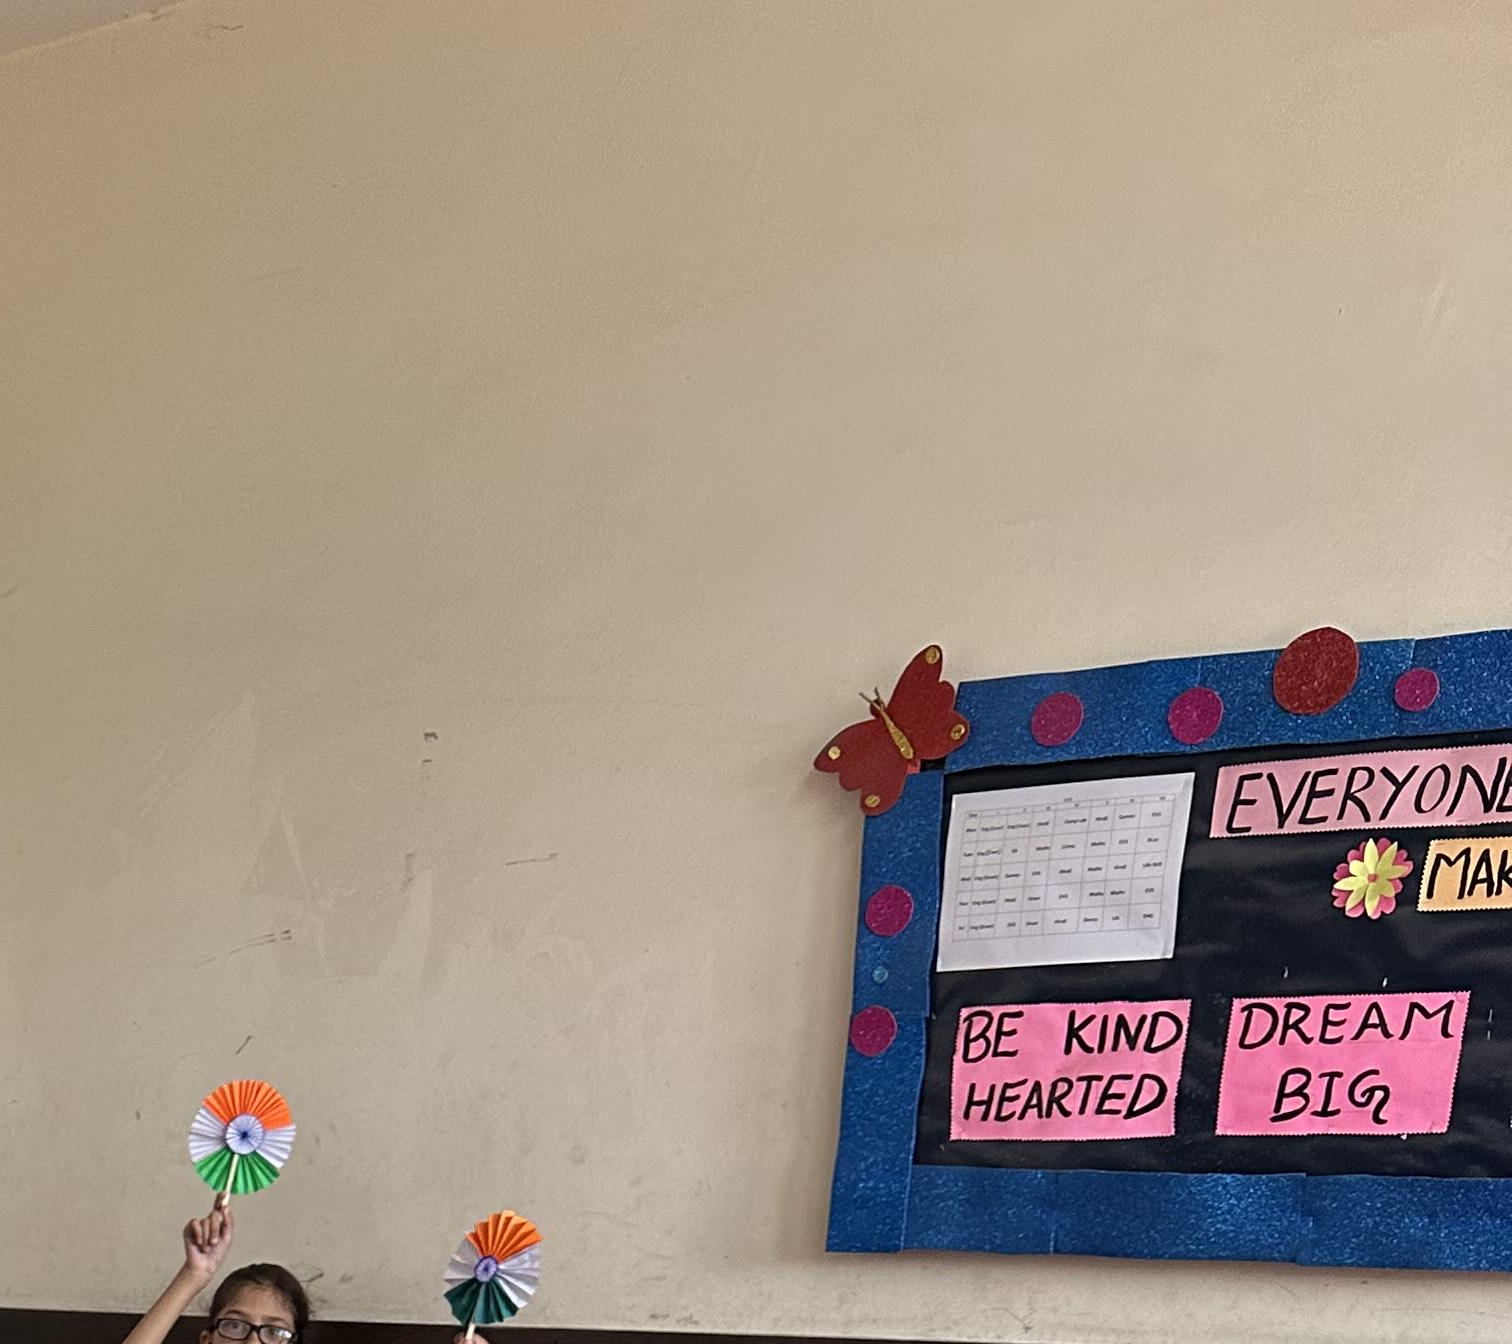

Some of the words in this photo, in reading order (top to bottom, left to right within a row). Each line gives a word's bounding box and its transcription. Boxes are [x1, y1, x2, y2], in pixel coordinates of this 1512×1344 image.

[962, 1010, 1024, 1063] BE
[1064, 1010, 1183, 1055] KIND
[1239, 1000, 1454, 1049] DREAM
[963, 1073, 1168, 1121] HEARTED
[1270, 1067, 1390, 1125] BIG
